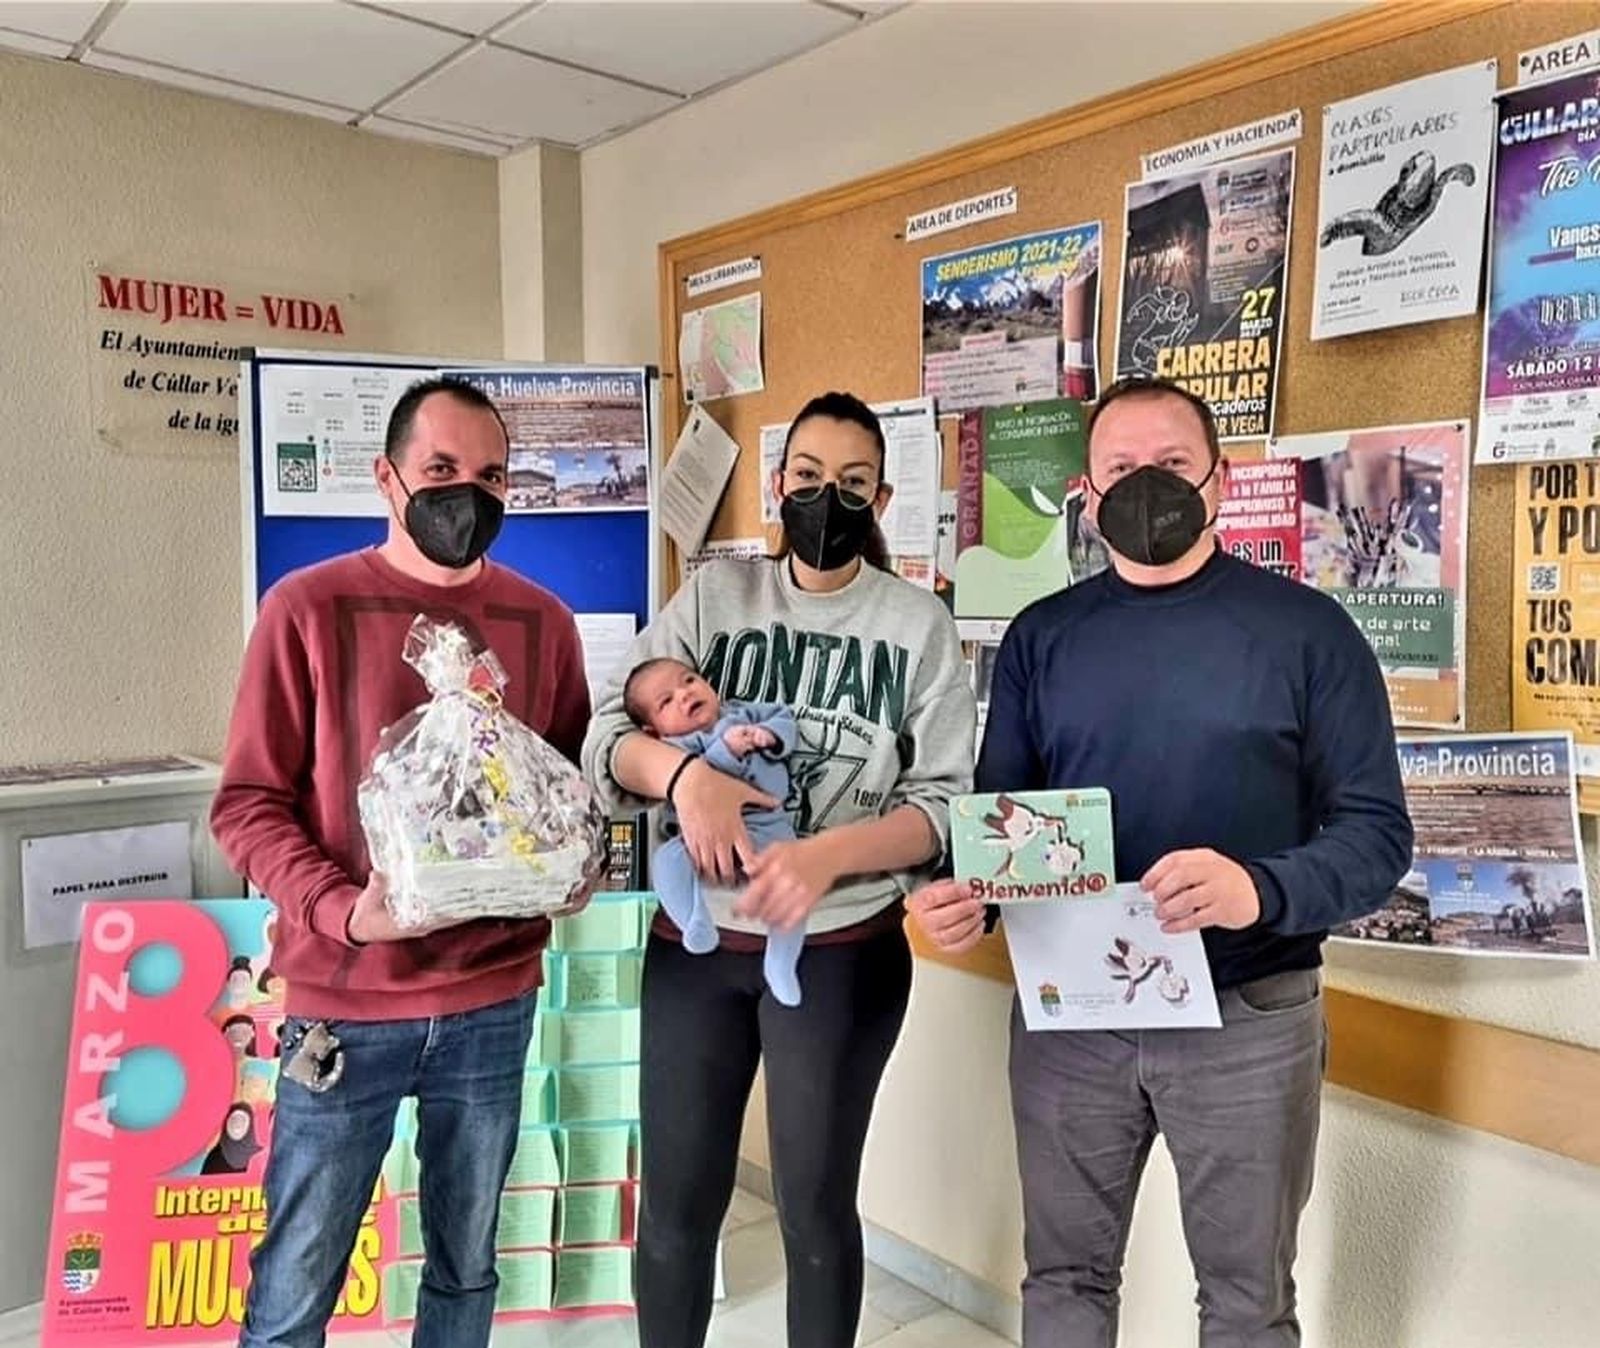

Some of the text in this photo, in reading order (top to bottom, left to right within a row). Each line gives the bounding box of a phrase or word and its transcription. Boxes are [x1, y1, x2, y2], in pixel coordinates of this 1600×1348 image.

[1530, 42, 1590, 75] AREA
[1214, 138, 1222, 151] Y
[1225, 115, 1298, 147] HACIENDA
[1329, 112, 1459, 161] PARTICULARES
[1331, 106, 1394, 138] CLASES
[1538, 155, 1580, 197] The
[909, 193, 1014, 234] AREA DE DEPORTES
[937, 247, 1018, 281] SENDERISMO
[1020, 235, 1082, 264] 2021-22
[98, 275, 344, 334] MUJER = VIDA
[1241, 287, 1275, 319] 27
[101, 330, 123, 350] El
[1157, 337, 1270, 376] CARRERA
[1574, 355, 1592, 371] 12
[124, 370, 146, 389] de
[151, 371, 210, 394] Cúllar
[168, 410, 190, 430] de
[194, 412, 211, 431] la
[1230, 415, 1264, 433] VEGA
[1529, 463, 1578, 500] POR
[1528, 506, 1549, 555] Y
[1260, 540, 1282, 561] un
[1346, 592, 1444, 608] APERTURA!
[1526, 599, 1572, 633] TUS
[1367, 617, 1431, 631] de arte
[52, 871, 168, 896] PAPEL PARA DESTRUIR
[64, 908, 135, 1213] MARZO
